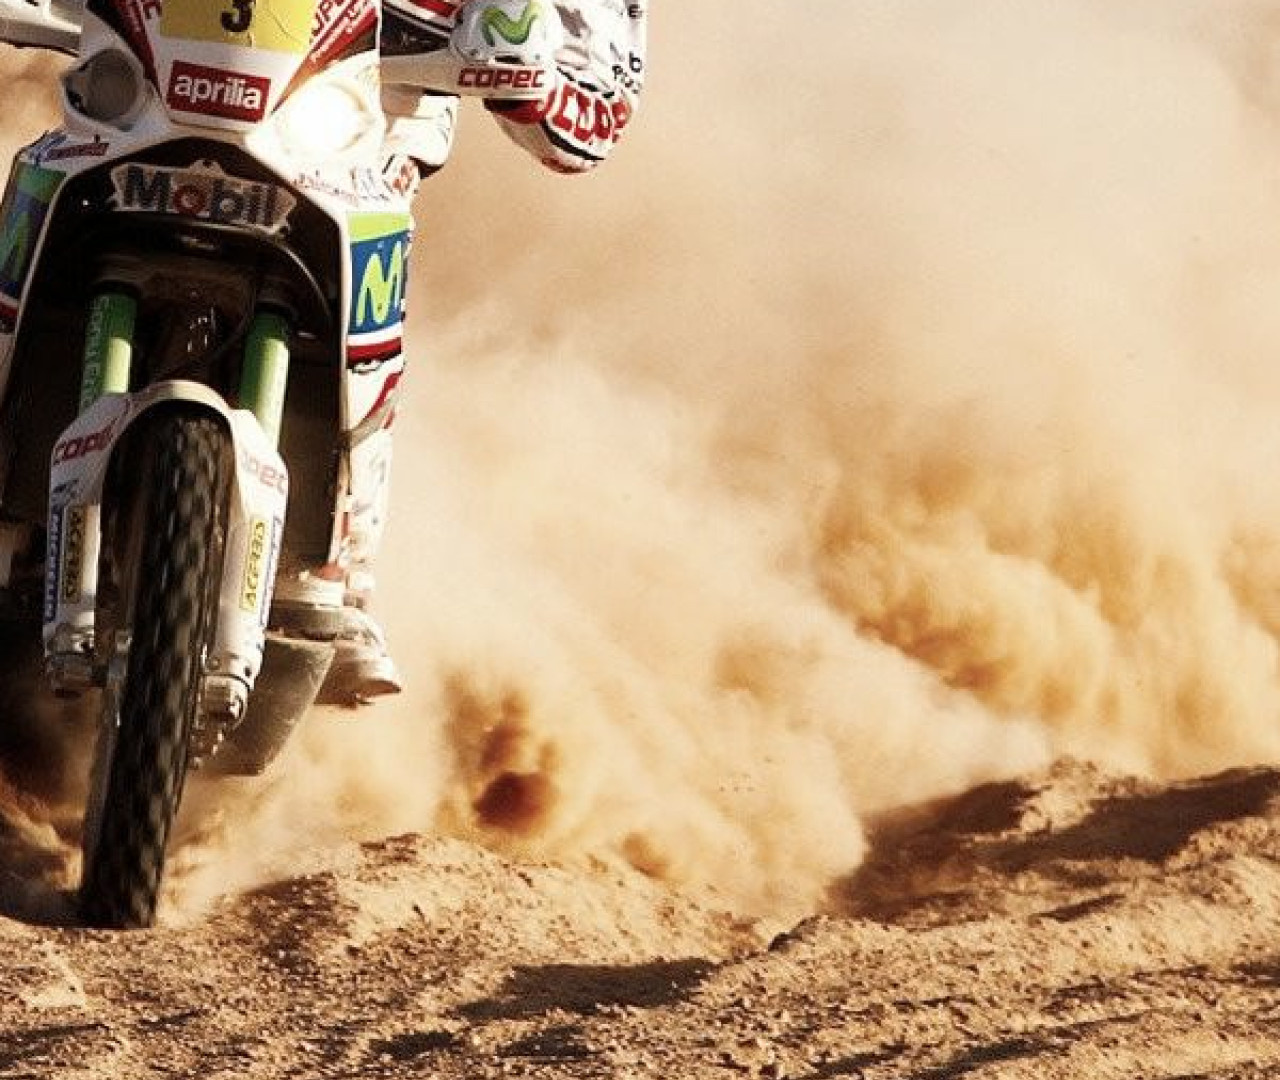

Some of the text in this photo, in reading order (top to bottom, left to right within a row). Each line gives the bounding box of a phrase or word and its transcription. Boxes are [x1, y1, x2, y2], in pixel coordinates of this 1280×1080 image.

[173, 73, 263, 111] aprilia
[458, 67, 546, 89] COPEC
[120, 165, 280, 226] Mobil
